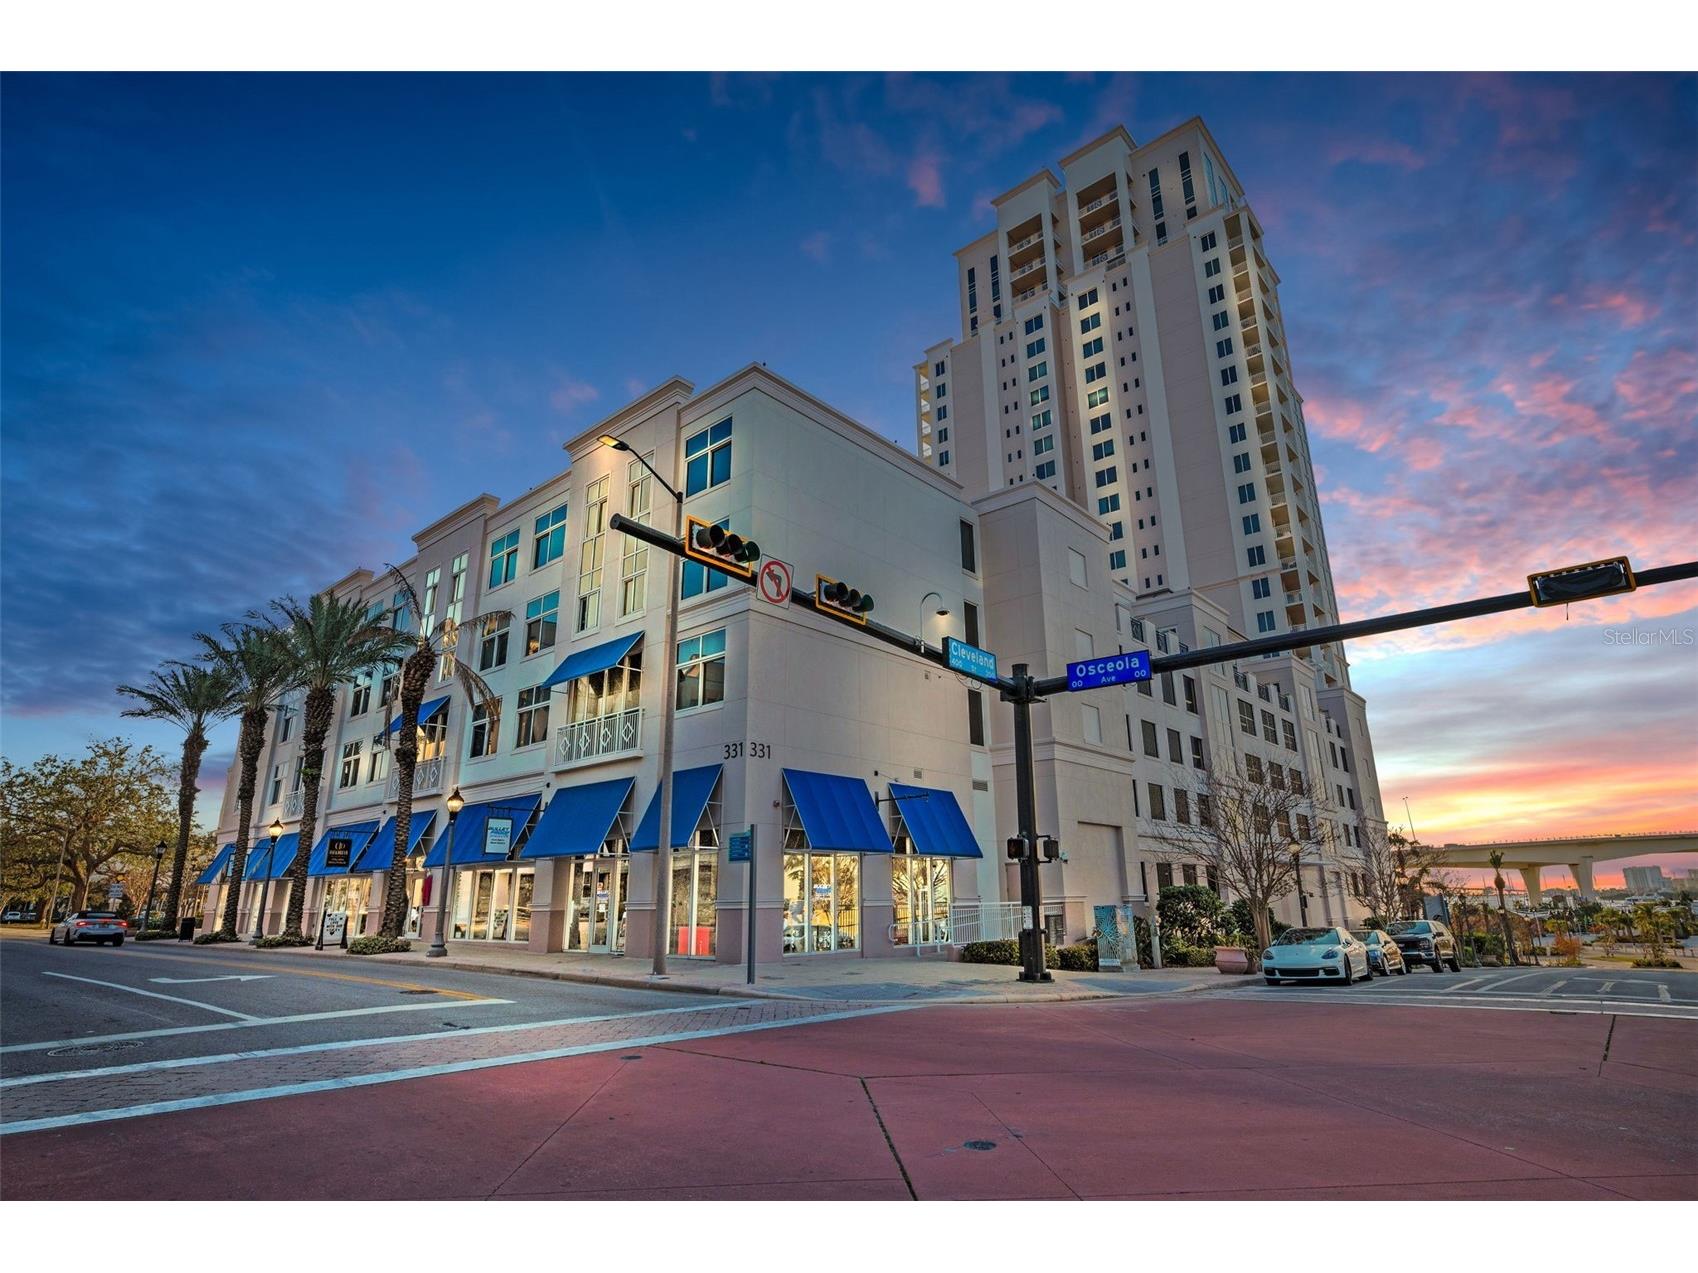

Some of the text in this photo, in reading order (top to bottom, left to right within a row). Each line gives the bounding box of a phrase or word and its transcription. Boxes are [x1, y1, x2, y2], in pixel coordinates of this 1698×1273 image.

[951, 641, 994, 669] Cleveland
[1076, 656, 1140, 677] Osceola
[1100, 675, 1116, 684] Ave
[1134, 669, 1147, 677] 00
[723, 742, 743, 760] 331
[749, 741, 771, 760] 331
